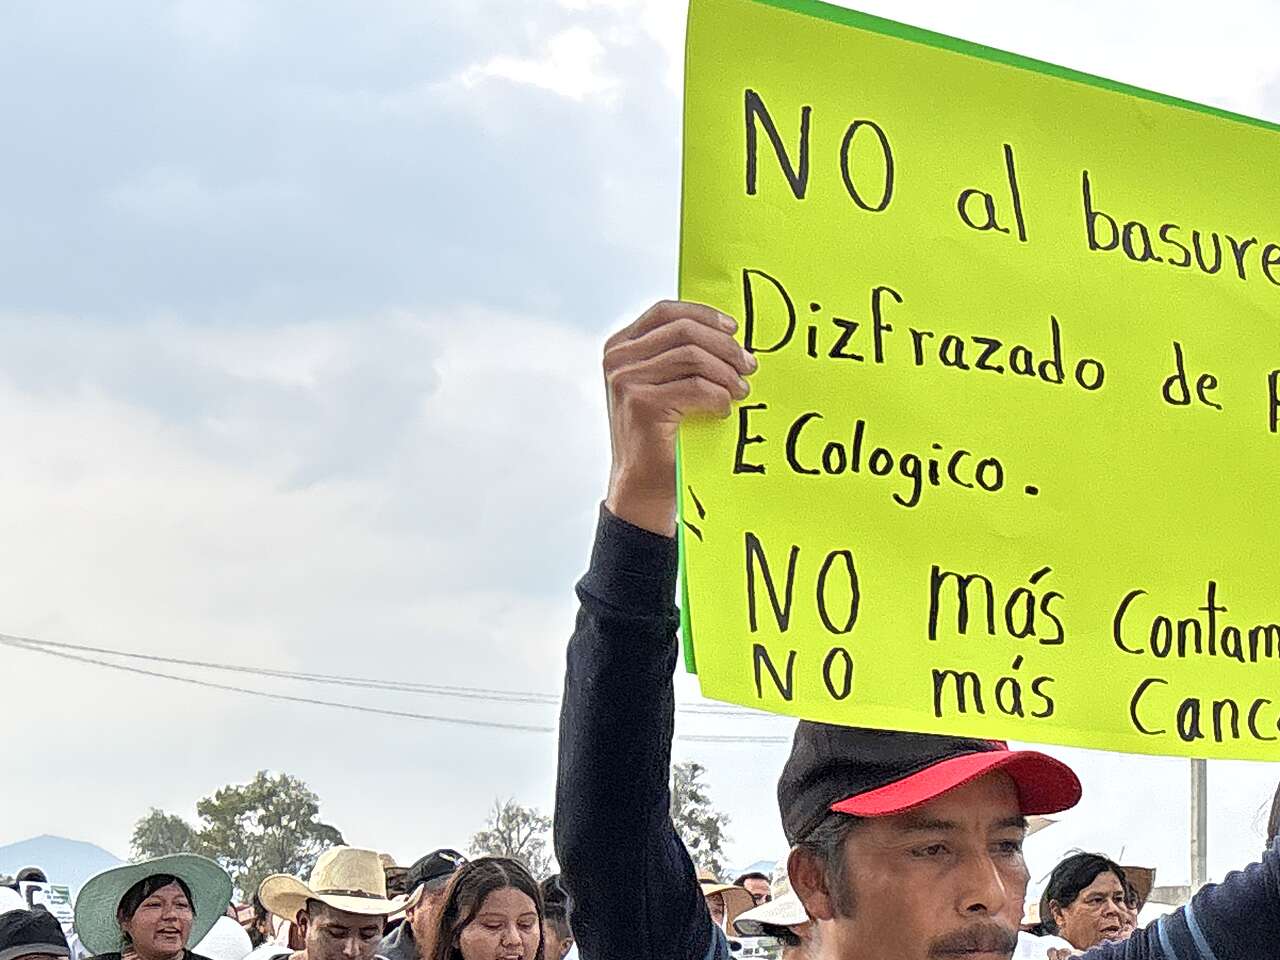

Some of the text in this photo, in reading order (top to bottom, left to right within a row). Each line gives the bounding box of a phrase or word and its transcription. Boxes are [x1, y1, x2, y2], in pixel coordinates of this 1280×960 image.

[745, 89, 894, 212] NO
[957, 143, 1028, 242] al
[743, 268, 1105, 390] Dizfrazado
[1162, 341, 1223, 410] de
[928, 565, 1065, 645] más
[753, 643, 853, 701] NO
[932, 655, 1055, 718] más
